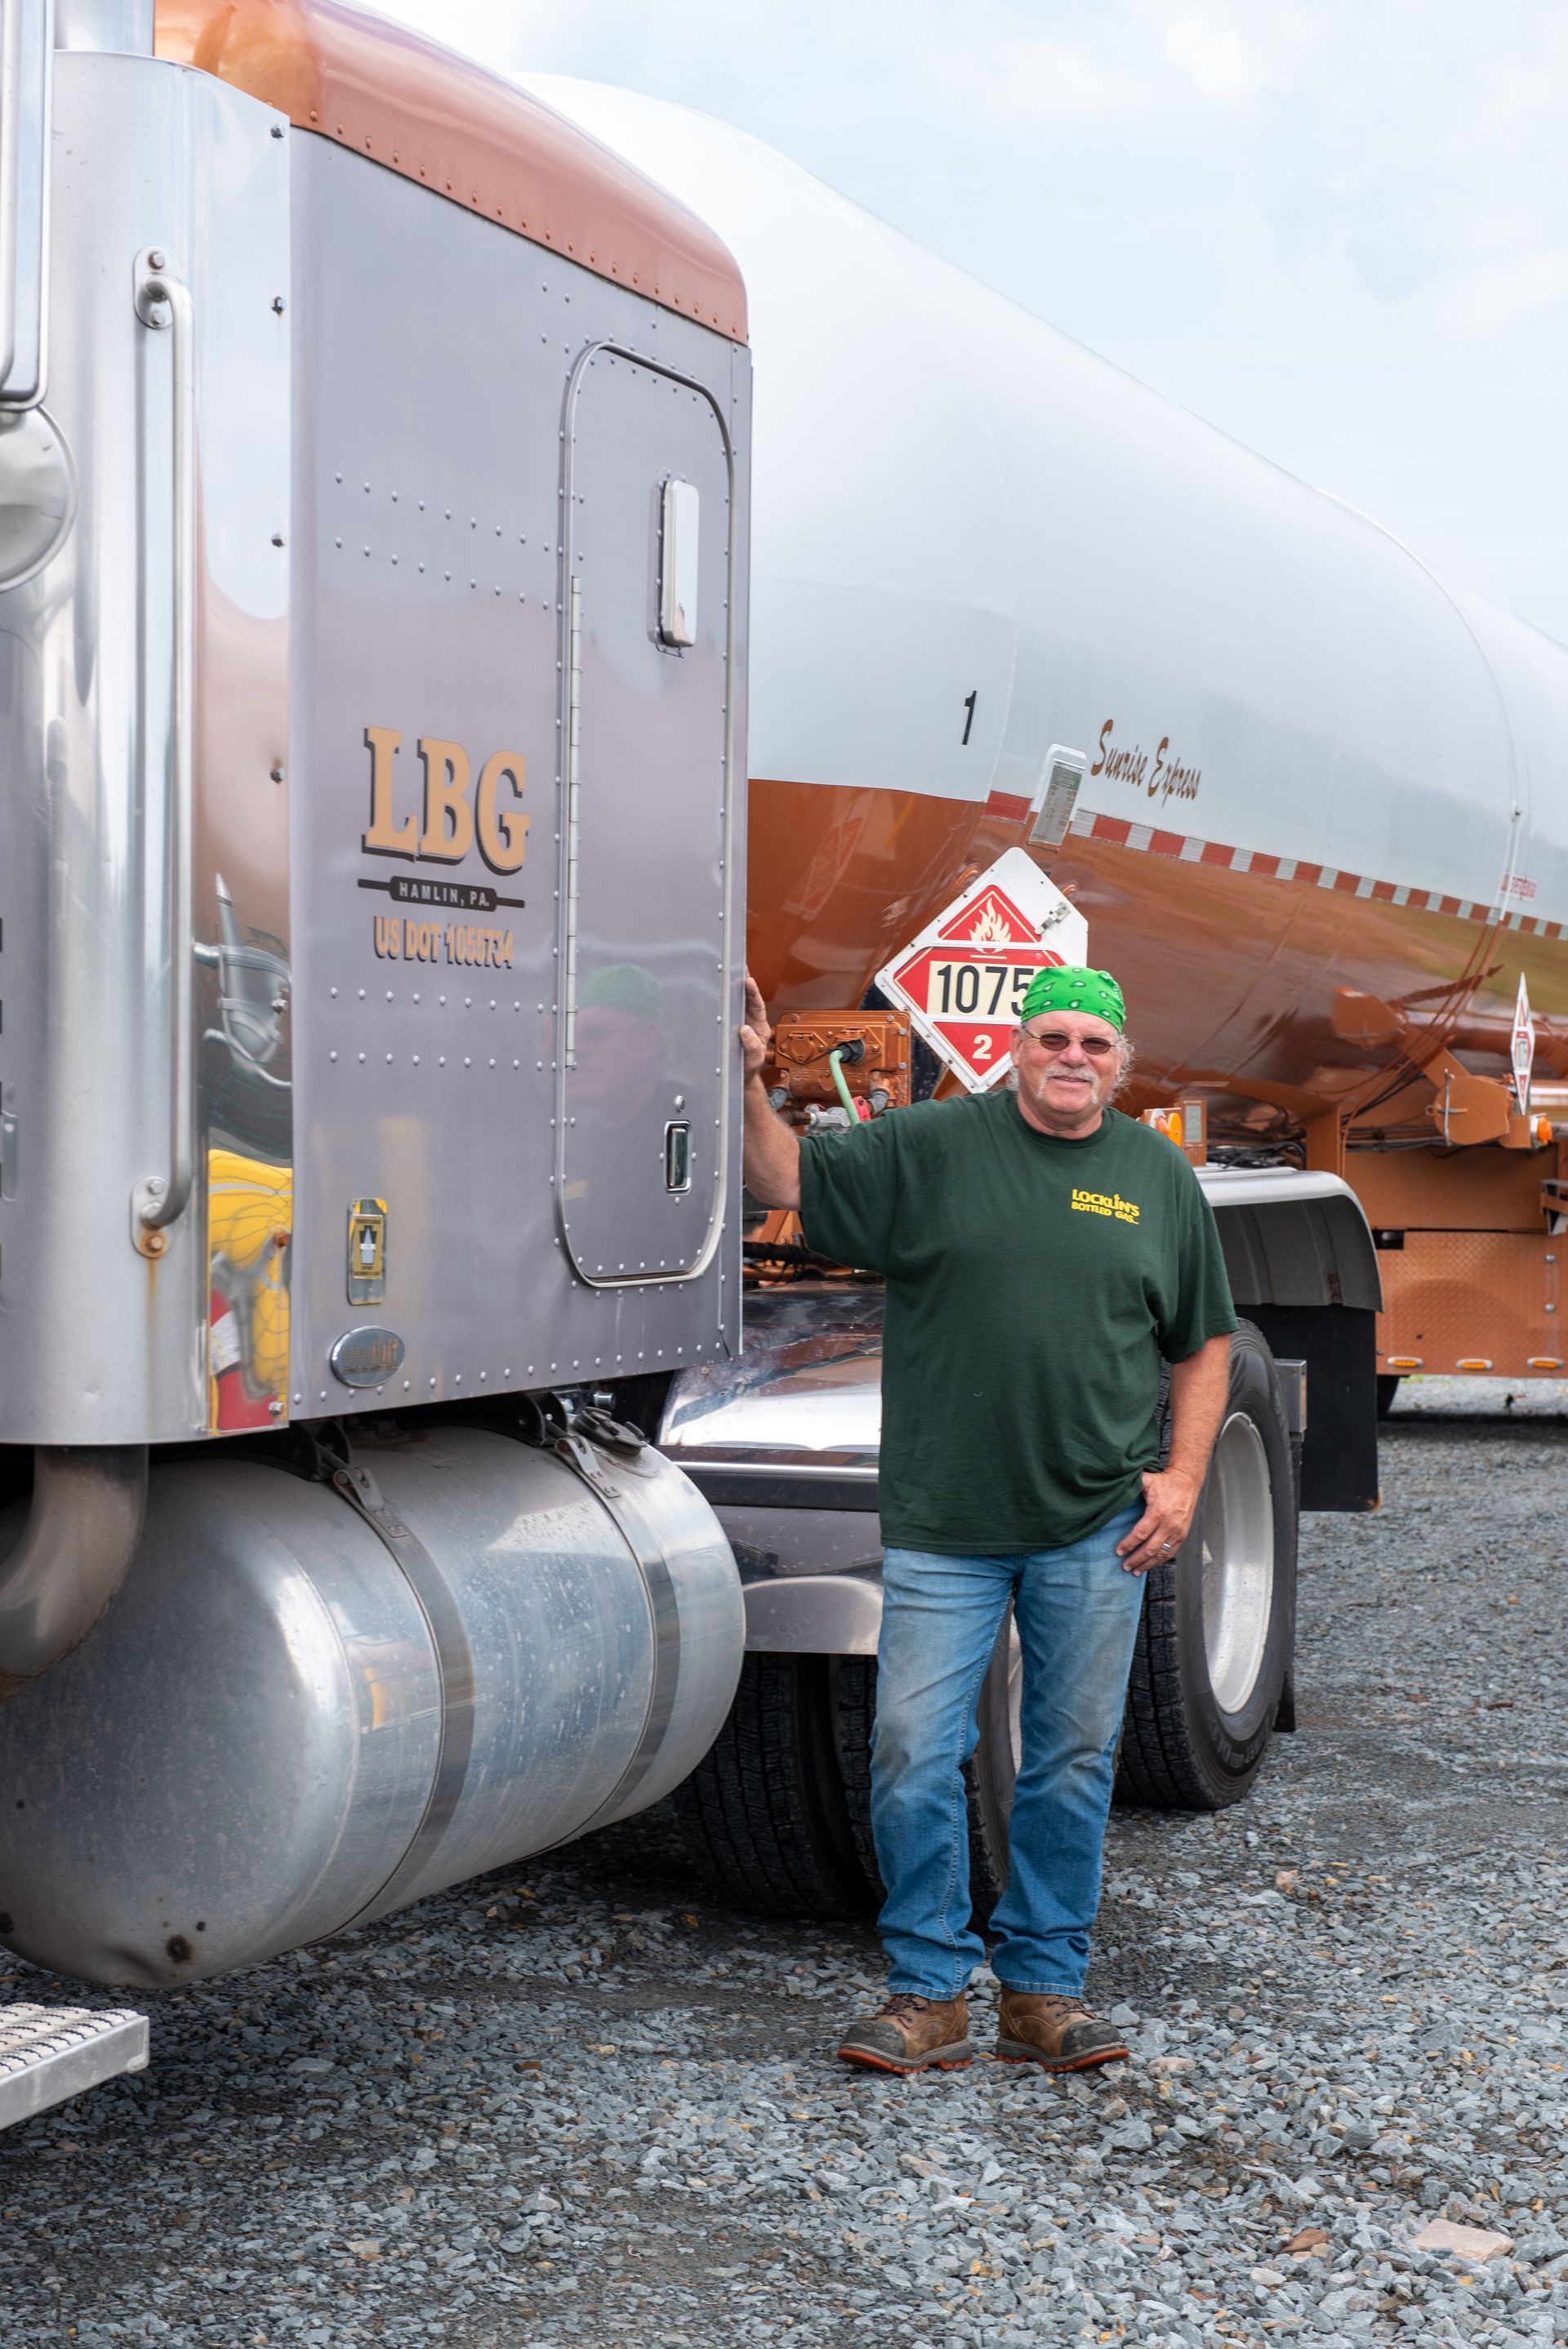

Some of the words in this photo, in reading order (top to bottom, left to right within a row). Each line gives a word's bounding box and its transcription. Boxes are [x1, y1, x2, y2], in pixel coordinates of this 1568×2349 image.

[961, 690, 978, 746] 1
[1091, 719, 1147, 787] Sunrise
[1147, 737, 1201, 809] Express
[361, 724, 529, 876] LBG
[399, 882, 465, 907] HAMLIN,
[373, 916, 400, 959] US
[403, 919, 440, 963] DOT
[937, 964, 1035, 1017] 1075
[972, 1034, 993, 1060] 2
[1071, 1201, 1112, 1216] BOTTLED
